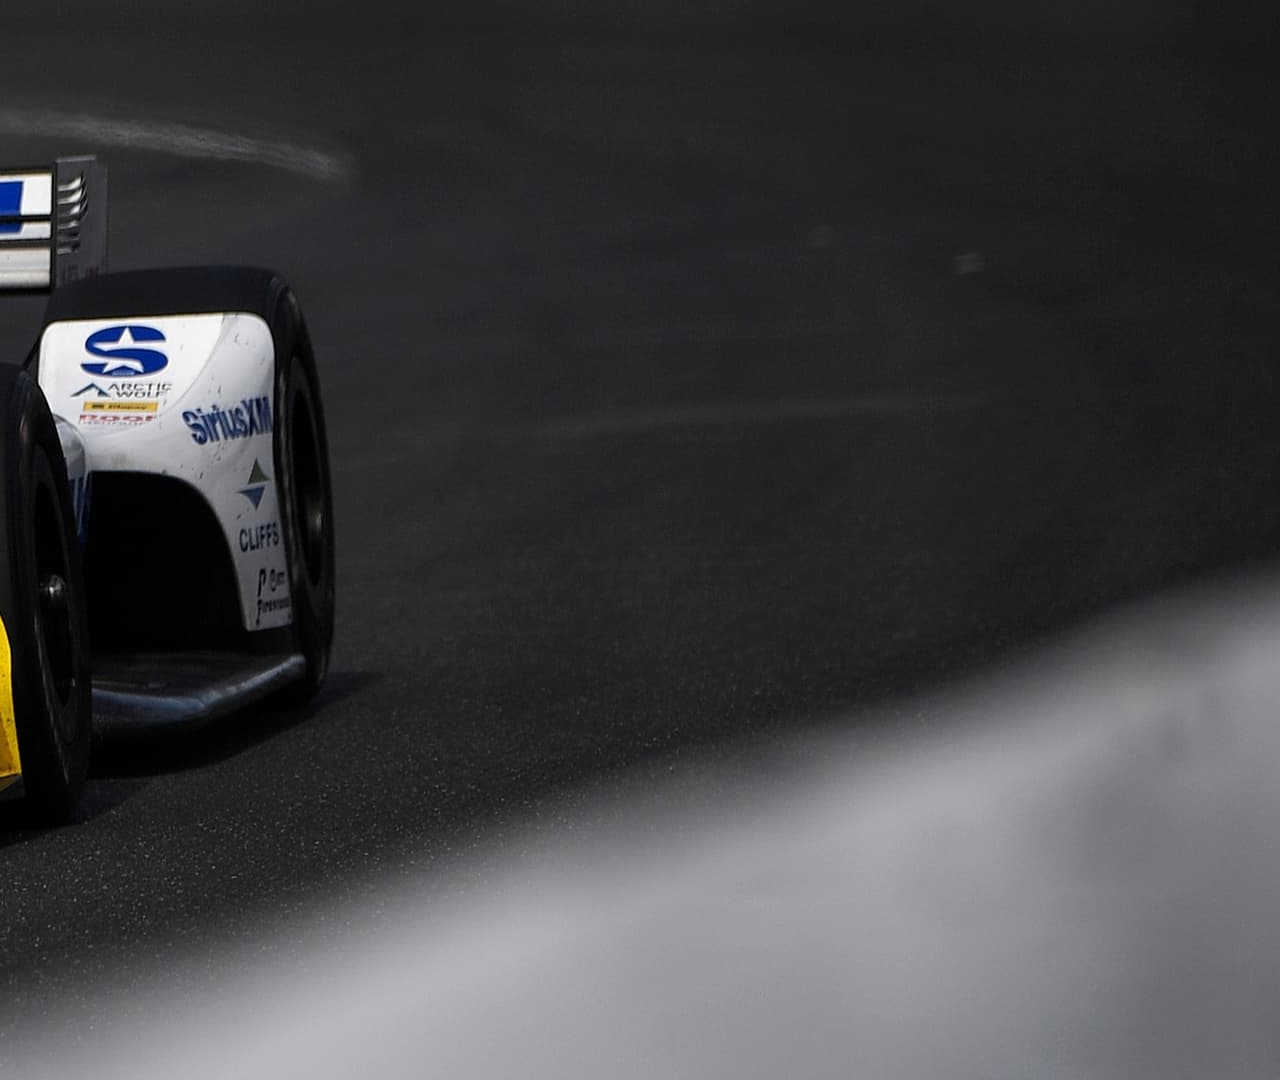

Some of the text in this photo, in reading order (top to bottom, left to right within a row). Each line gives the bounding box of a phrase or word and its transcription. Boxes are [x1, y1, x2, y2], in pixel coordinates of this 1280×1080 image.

[107, 383, 172, 391] ARCTIC
[182, 396, 273, 445] SiriusXM
[240, 522, 279, 552] CLIFFS
